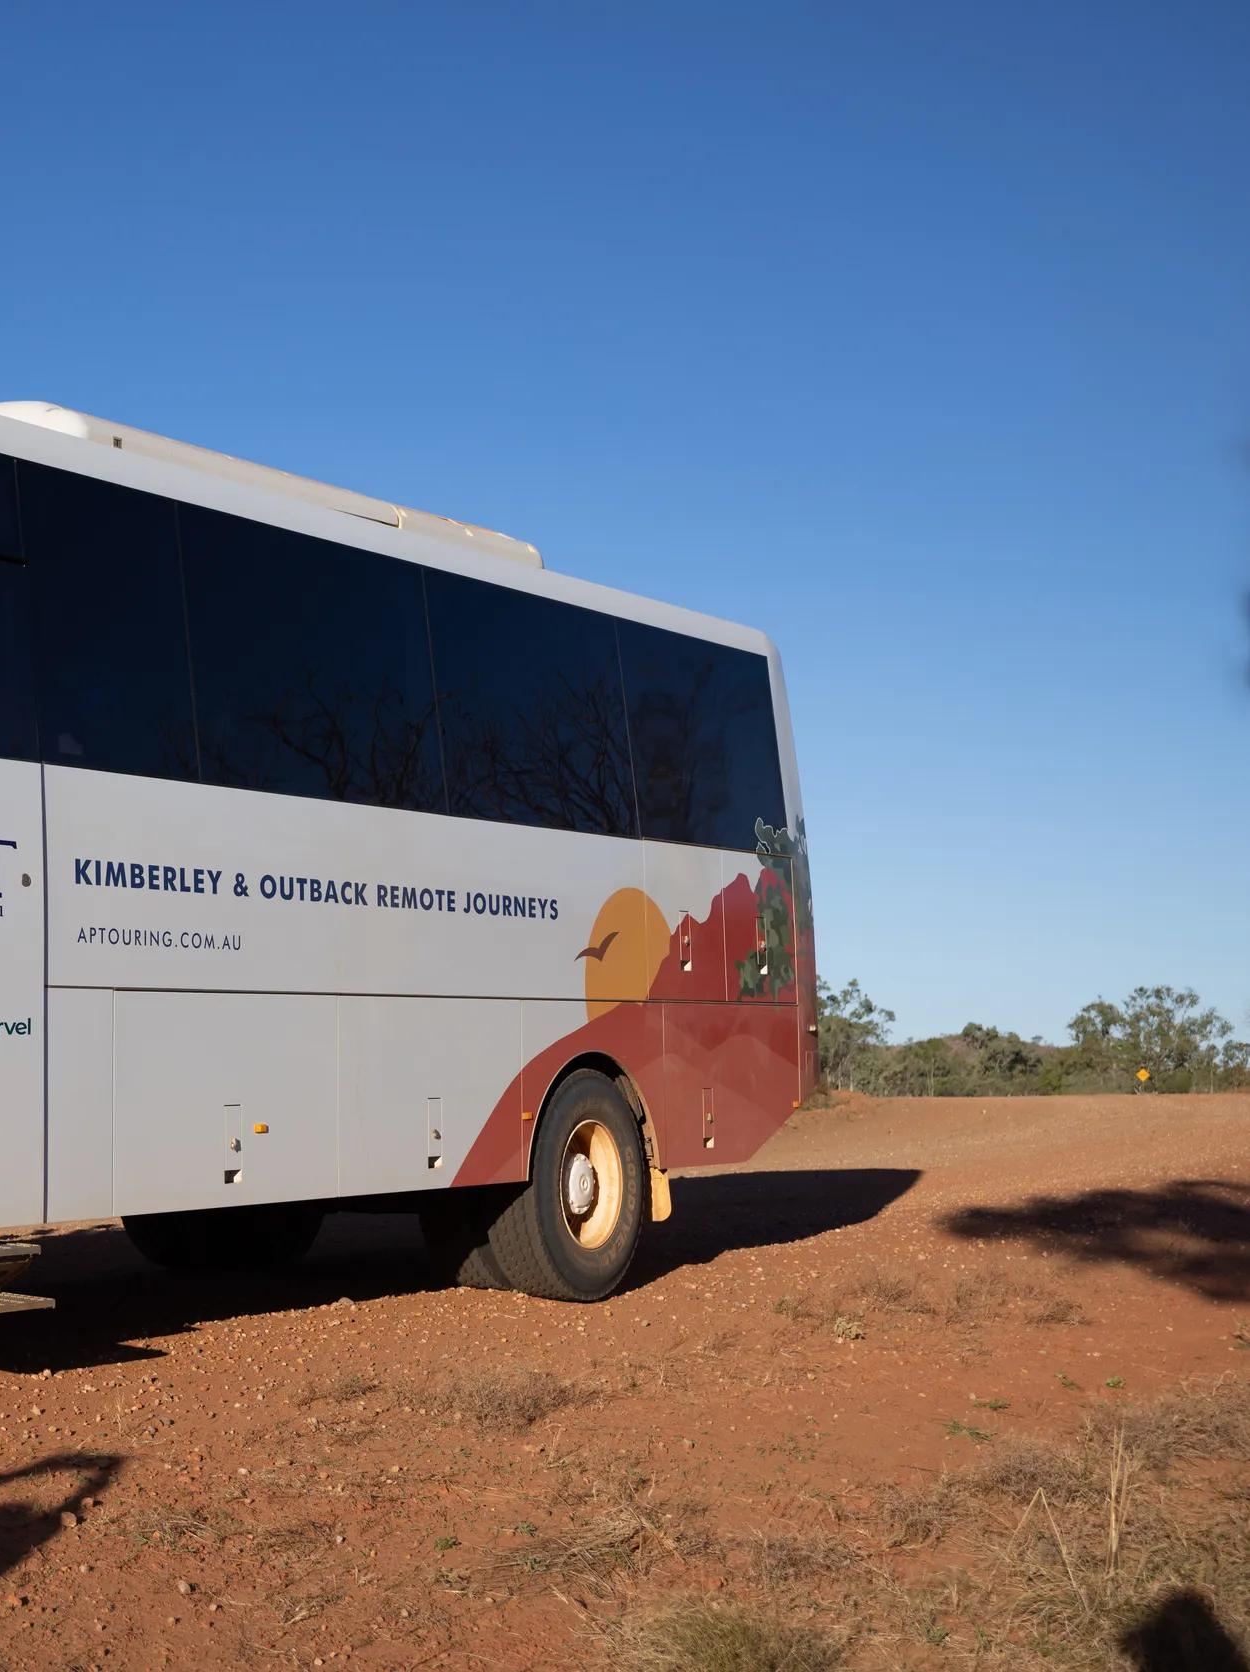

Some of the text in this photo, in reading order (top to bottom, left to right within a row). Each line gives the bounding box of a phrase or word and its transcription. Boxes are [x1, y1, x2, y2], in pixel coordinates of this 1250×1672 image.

[75, 858, 559, 920] KIMBERLEY & OUTBACK REMOTE JOURNEYS
[77, 927, 242, 951] APTOURING.COM.AU
